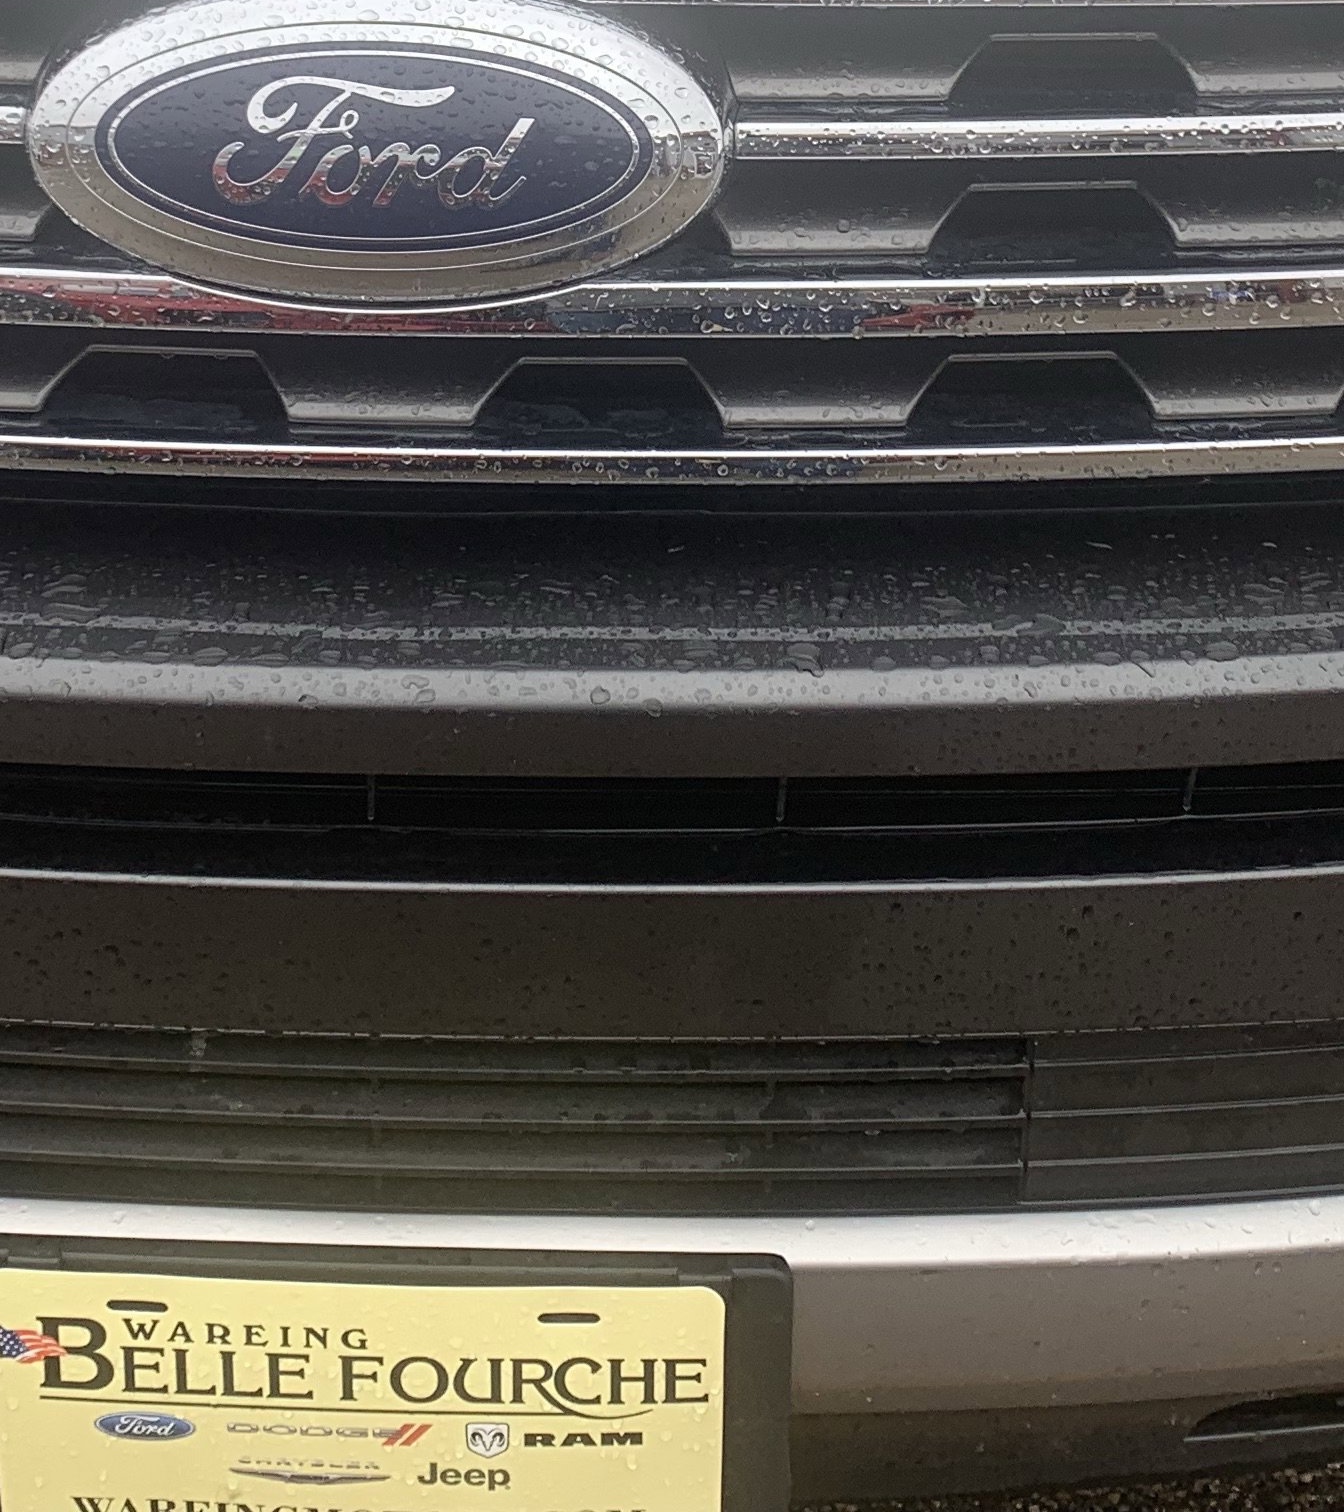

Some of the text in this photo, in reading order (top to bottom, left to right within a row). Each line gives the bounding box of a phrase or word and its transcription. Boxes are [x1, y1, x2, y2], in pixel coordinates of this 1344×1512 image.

[212, 75, 536, 208] Ford
[122, 1318, 369, 1350] WAREING
[36, 1316, 709, 1418] BELLE FOURCHE
[114, 1414, 644, 1448] Ford DODGE RAM
[237, 1454, 511, 1490] CHRYSLER Jeep
